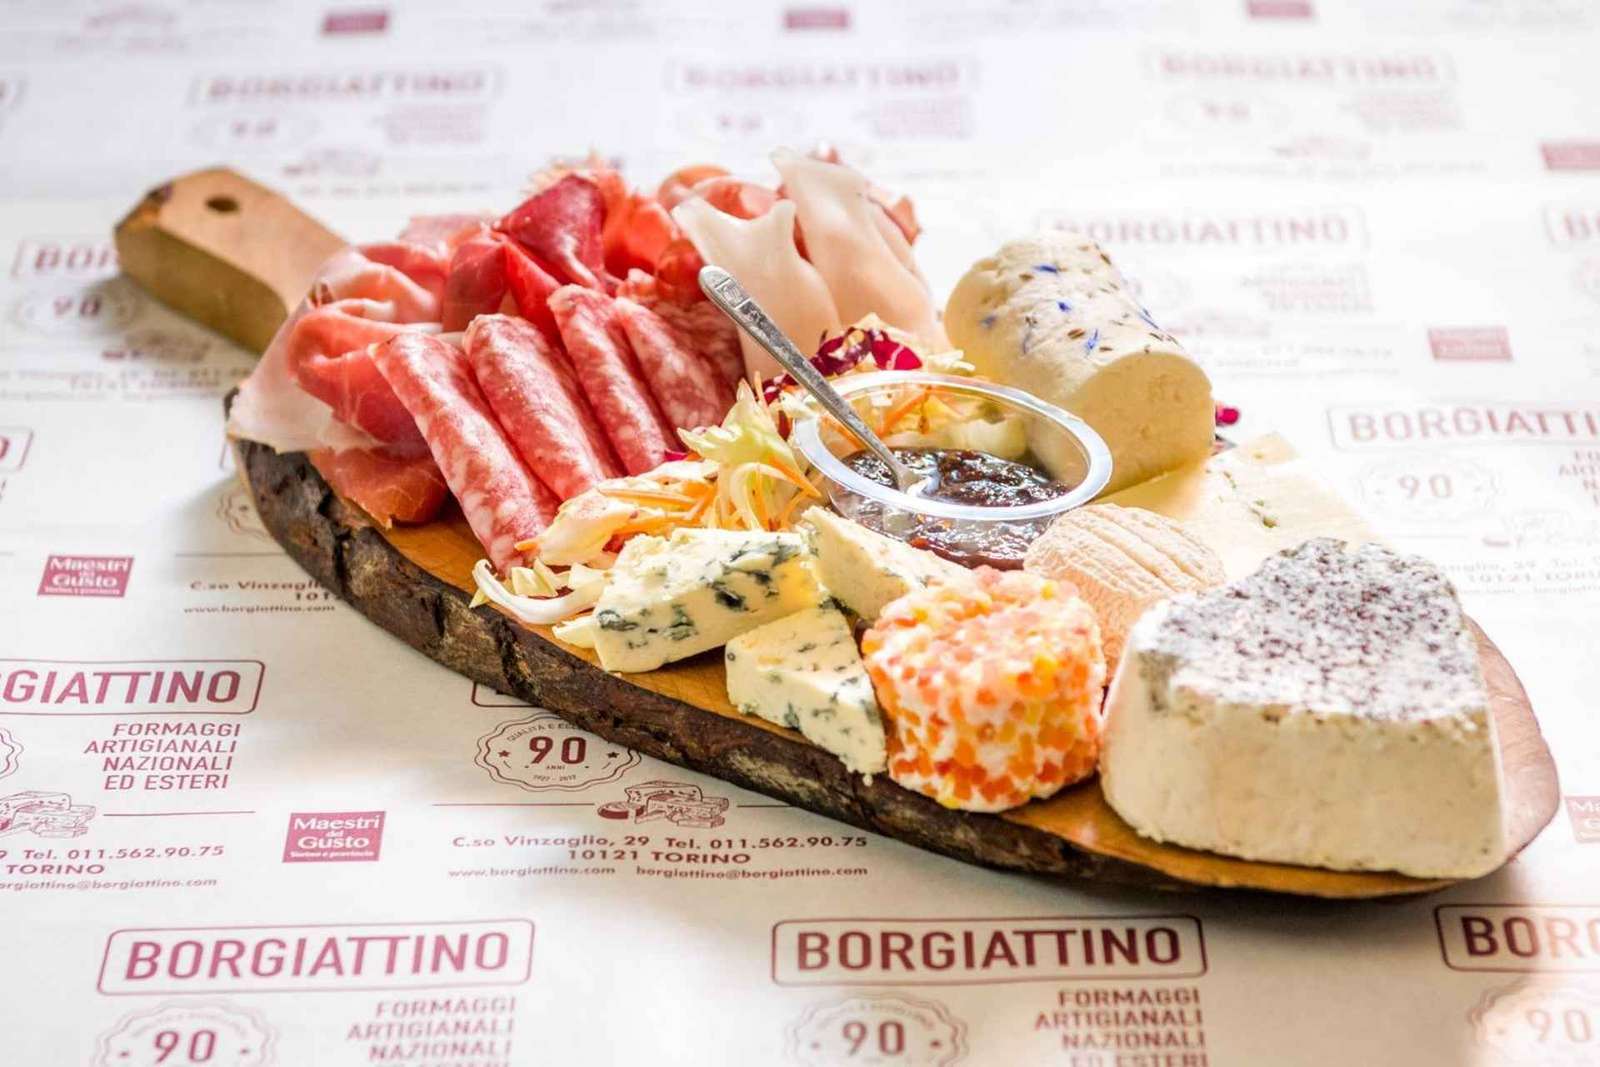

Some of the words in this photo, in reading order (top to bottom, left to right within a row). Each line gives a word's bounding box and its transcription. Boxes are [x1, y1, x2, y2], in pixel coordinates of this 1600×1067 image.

[1397, 473, 1454, 500] 90
[50, 558, 129, 571] Maestri
[52, 573, 118, 588] Gusto
[113, 722, 241, 738] FORMAGGI
[84, 739, 237, 754] ARTIGIANALI
[529, 735, 587, 765] 90
[103, 755, 233, 771] NAZIONALI
[104, 774, 135, 790] ED
[144, 773, 230, 790] ESTERI
[294, 814, 381, 830] Maestri
[297, 836, 370, 849] Gusto
[452, 836, 496, 848] C.so
[504, 834, 615, 849] Vinzaglio,
[624, 835, 650, 847] 29
[665, 837, 700, 850] Tel.
[710, 836, 868, 850] 011.562.90.75
[23, 849, 58, 860] Tel.
[67, 845, 225, 861] 011.562.90.75
[569, 849, 639, 861] 10121
[651, 851, 751, 864] TORINO
[6, 864, 105, 875] TORINO
[448, 865, 615, 878] www.borgiattino.com
[636, 865, 868, 881] borgiattino@borgiattino.com
[125, 931, 509, 980] BORGIATTINO
[797, 926, 1181, 972] BORGIATTINO
[1058, 988, 1200, 1007] FORMAGGI
[375, 997, 516, 1017] FORMAGGI
[1035, 1009, 1203, 1031] ARTIGIANALI
[1525, 1008, 1593, 1043] 90
[345, 1018, 513, 1041] ARTIGIANALI
[152, 1029, 217, 1064] 90
[842, 1020, 905, 1058] 90
[1062, 1030, 1205, 1050] NAZIONALI
[368, 1039, 512, 1061] NAZIONALI
